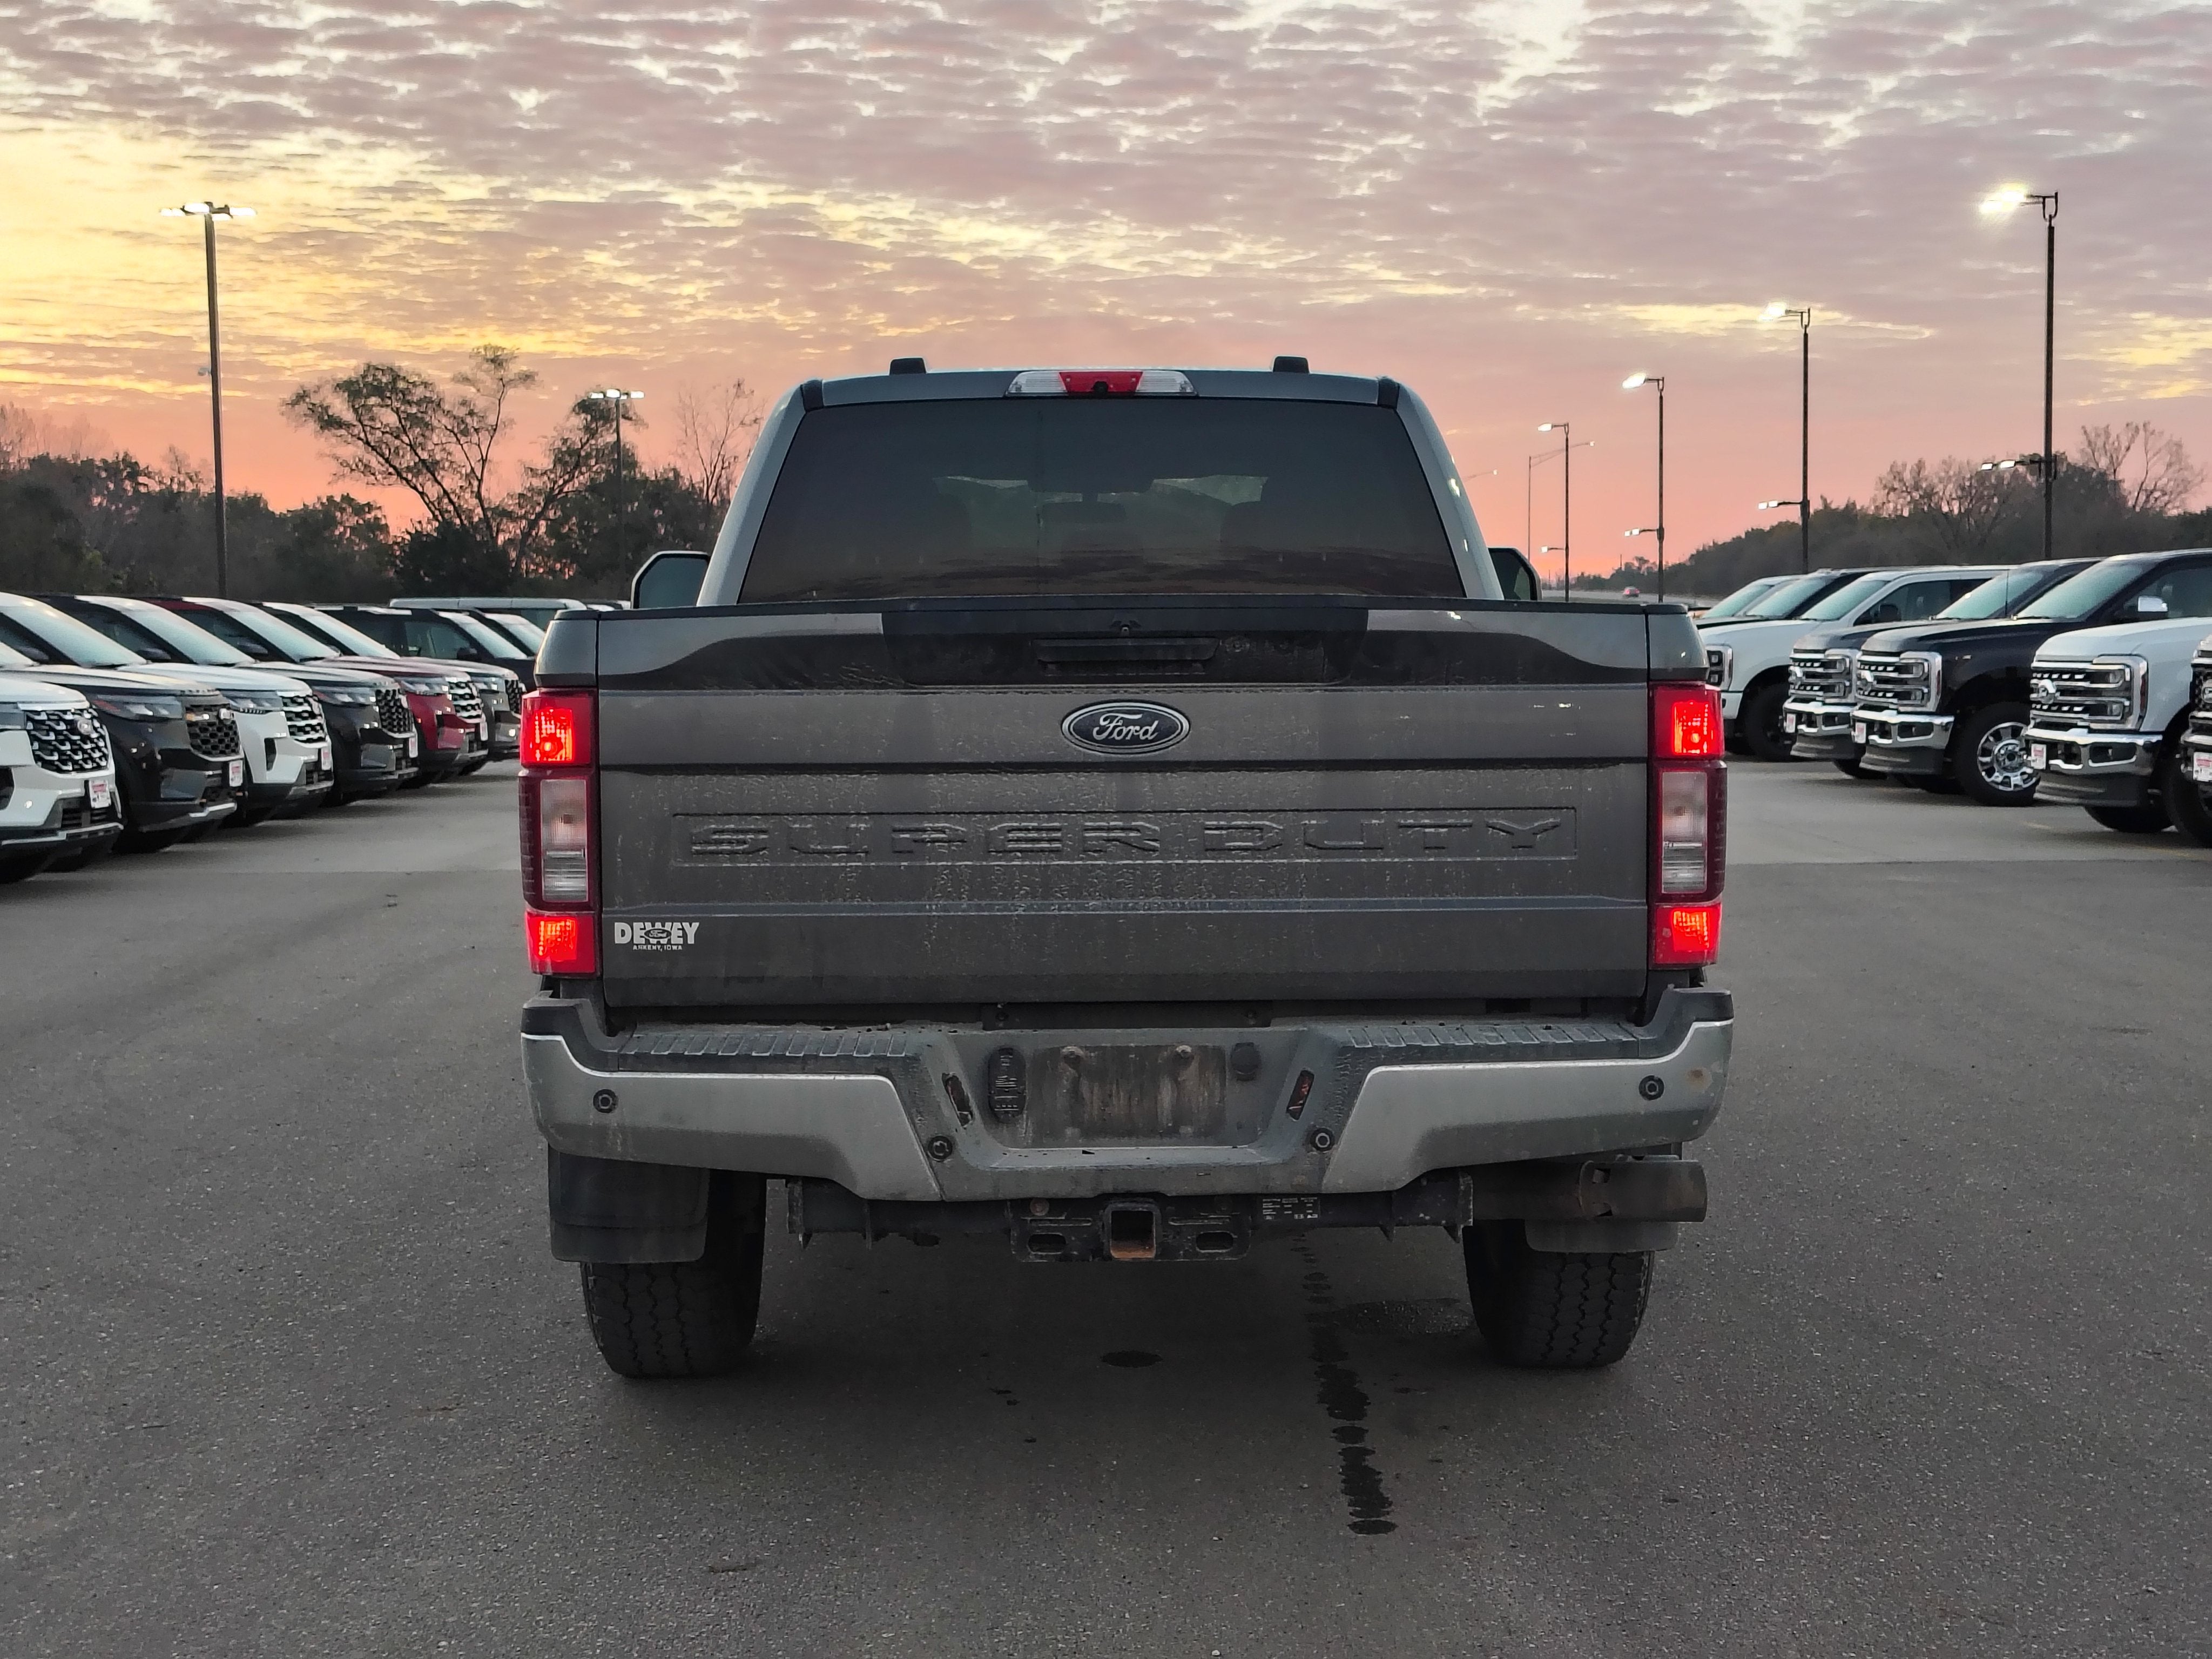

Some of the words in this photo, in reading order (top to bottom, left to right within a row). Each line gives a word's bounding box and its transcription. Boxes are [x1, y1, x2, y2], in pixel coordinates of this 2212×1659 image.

[1092, 712, 1159, 740] Ford
[691, 821, 1161, 855] SUPER
[1204, 818, 1561, 852] DUTY
[614, 922, 700, 944] DEWEY
